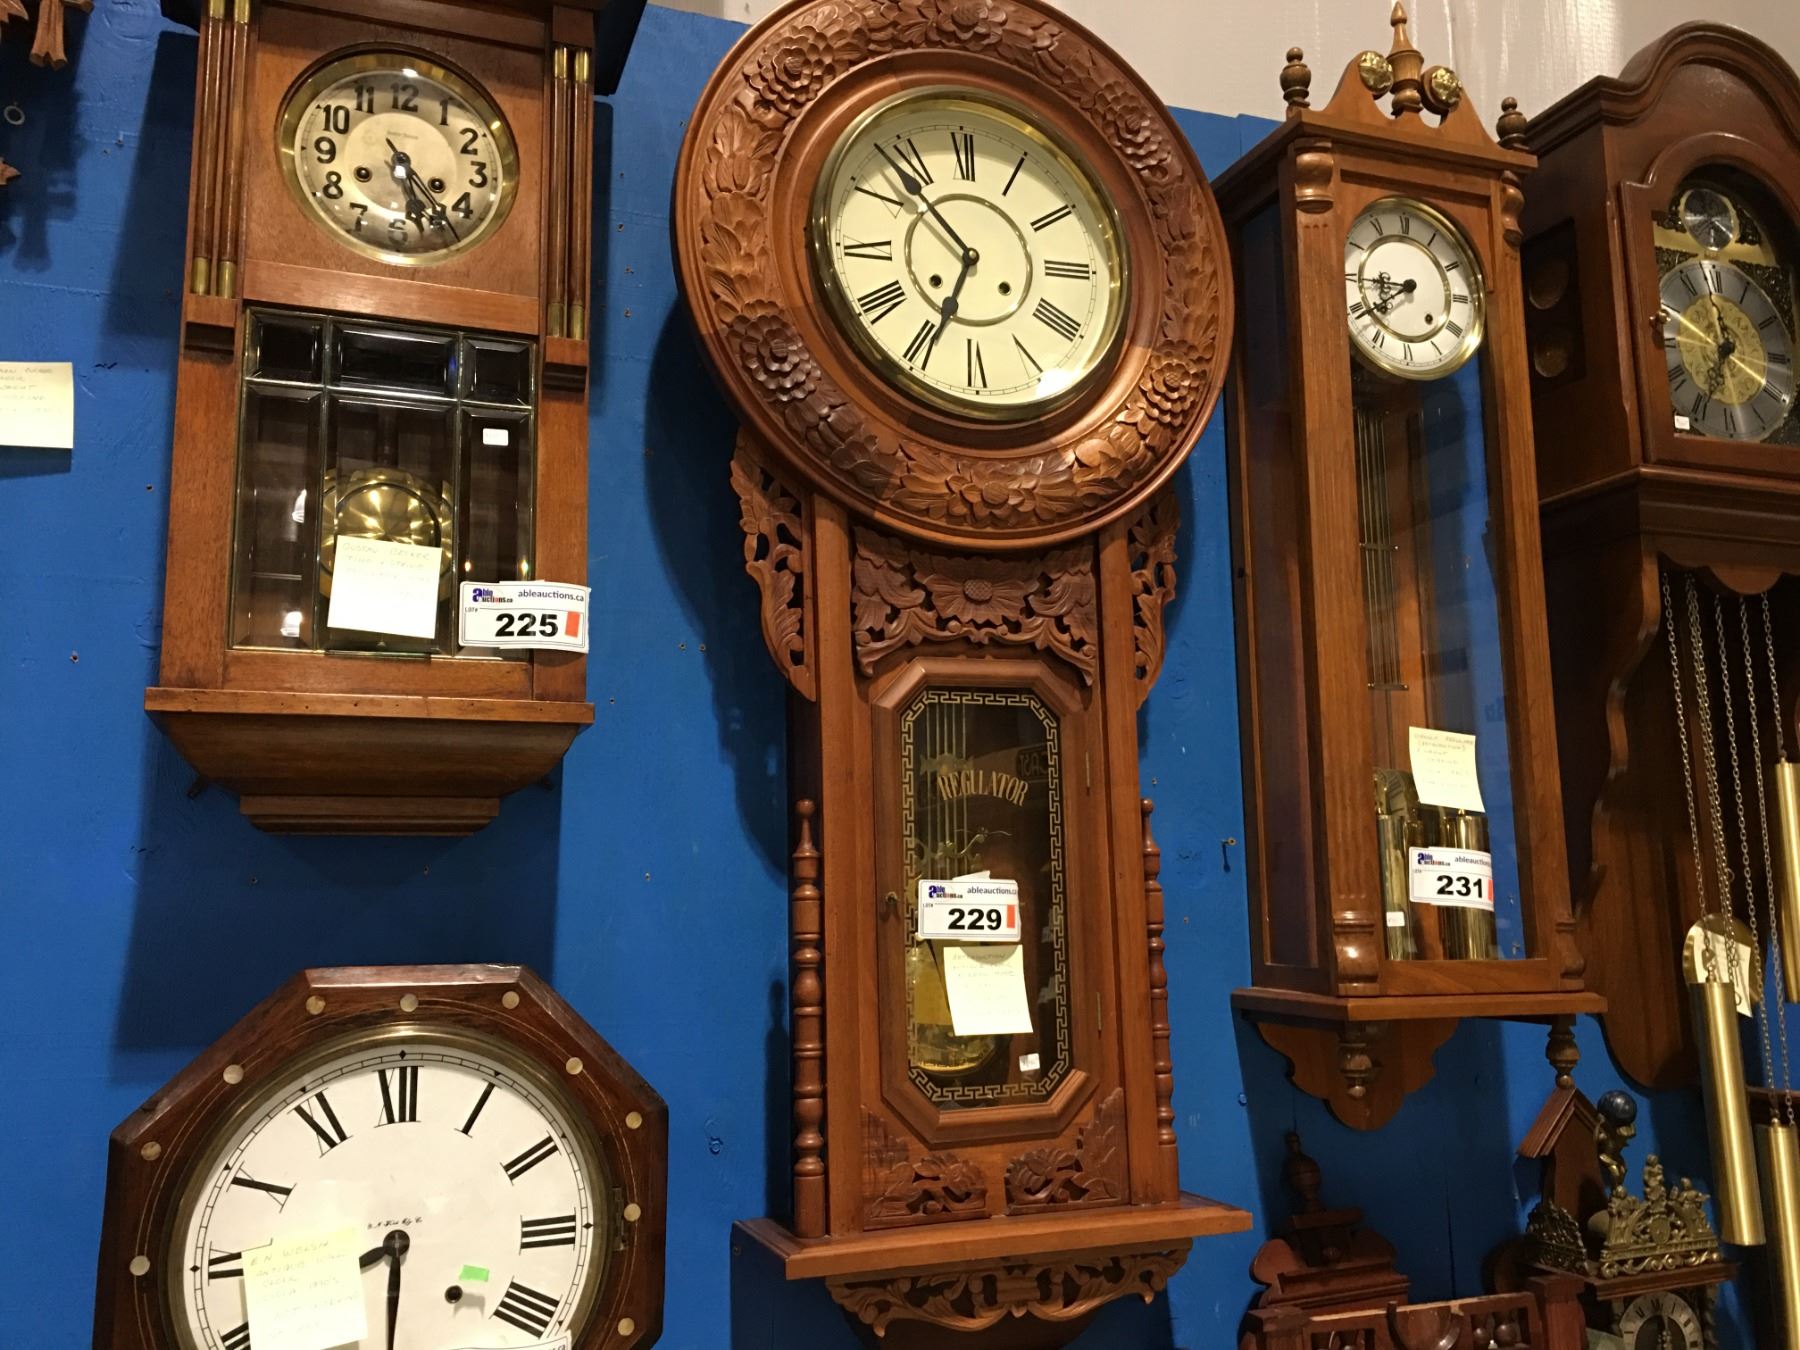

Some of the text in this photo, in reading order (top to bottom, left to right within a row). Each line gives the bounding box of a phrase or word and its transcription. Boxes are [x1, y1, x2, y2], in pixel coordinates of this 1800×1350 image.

[354, 85, 375, 114] 11
[391, 83, 418, 112] 12
[440, 99, 449, 126] 1
[322, 104, 350, 135] 10
[314, 136, 337, 164] 9
[459, 128, 479, 156] 2
[950, 131, 975, 182] XII
[468, 161, 488, 188] 3
[893, 137, 934, 187] XI
[322, 171, 343, 200] 8
[854, 173, 904, 219] X
[350, 202, 368, 232] 7
[451, 192, 473, 219] 4
[1030, 204, 1072, 232] II
[843, 235, 893, 261] IX
[1044, 259, 1090, 280] III
[857, 280, 907, 325] VIII
[1452, 293, 1469, 305] III
[1032, 297, 1081, 342] IIII
[902, 319, 936, 372] VII
[1011, 333, 1043, 379] V
[967, 337, 988, 389] VI
[518, 589, 585, 602] ableauctions.ca
[495, 613, 559, 637] 225
[937, 769, 1029, 807] REGULATOR
[1436, 874, 1483, 898] 231
[948, 908, 1002, 931] 229
[374, 1065, 424, 1128] XII
[455, 1079, 502, 1138] I
[286, 1087, 353, 1158] XI
[500, 1130, 561, 1186] II
[226, 1161, 297, 1213] X
[519, 1207, 577, 1255] III
[488, 1276, 564, 1340] IIII
